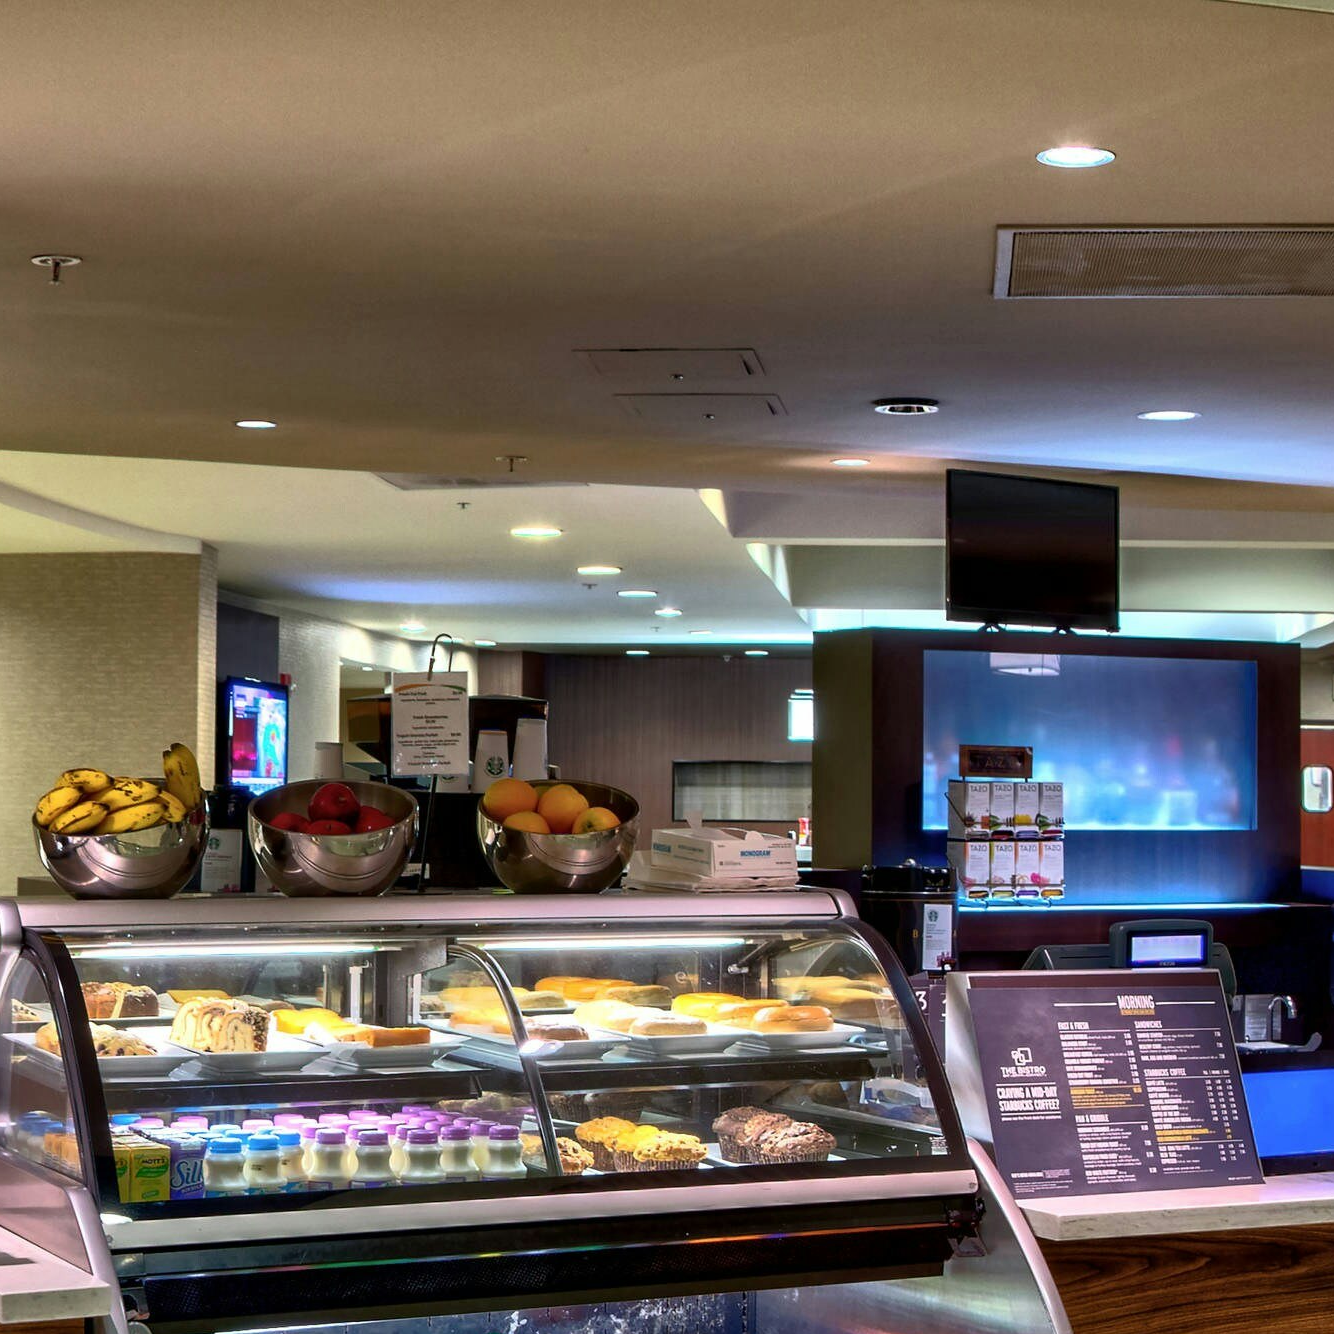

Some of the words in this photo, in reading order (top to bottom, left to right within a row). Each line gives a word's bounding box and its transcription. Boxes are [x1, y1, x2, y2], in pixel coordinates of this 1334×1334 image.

[970, 785, 987, 793] TAZO
[995, 784, 1012, 792] TAZO
[1019, 784, 1037, 792] TAZO
[1045, 784, 1061, 792] TAZO
[970, 844, 987, 852] TAZO
[995, 844, 1013, 852] TAZO
[1019, 844, 1037, 852] TAZO
[1044, 844, 1061, 852] TAZO
[741, 850, 771, 858] MONOGRAM
[1117, 995, 1155, 1009] MORNING
[1000, 1066, 1017, 1076] THE
[1018, 1066, 1046, 1076] BISTRO
[996, 1088, 1025, 1099] CRAVING
[1025, 1087, 1031, 1098] A
[1031, 1086, 1057, 1098] MID-DAY
[999, 1100, 1034, 1112] STARBUCKS
[1035, 1098, 1060, 1110] COFFEE?
